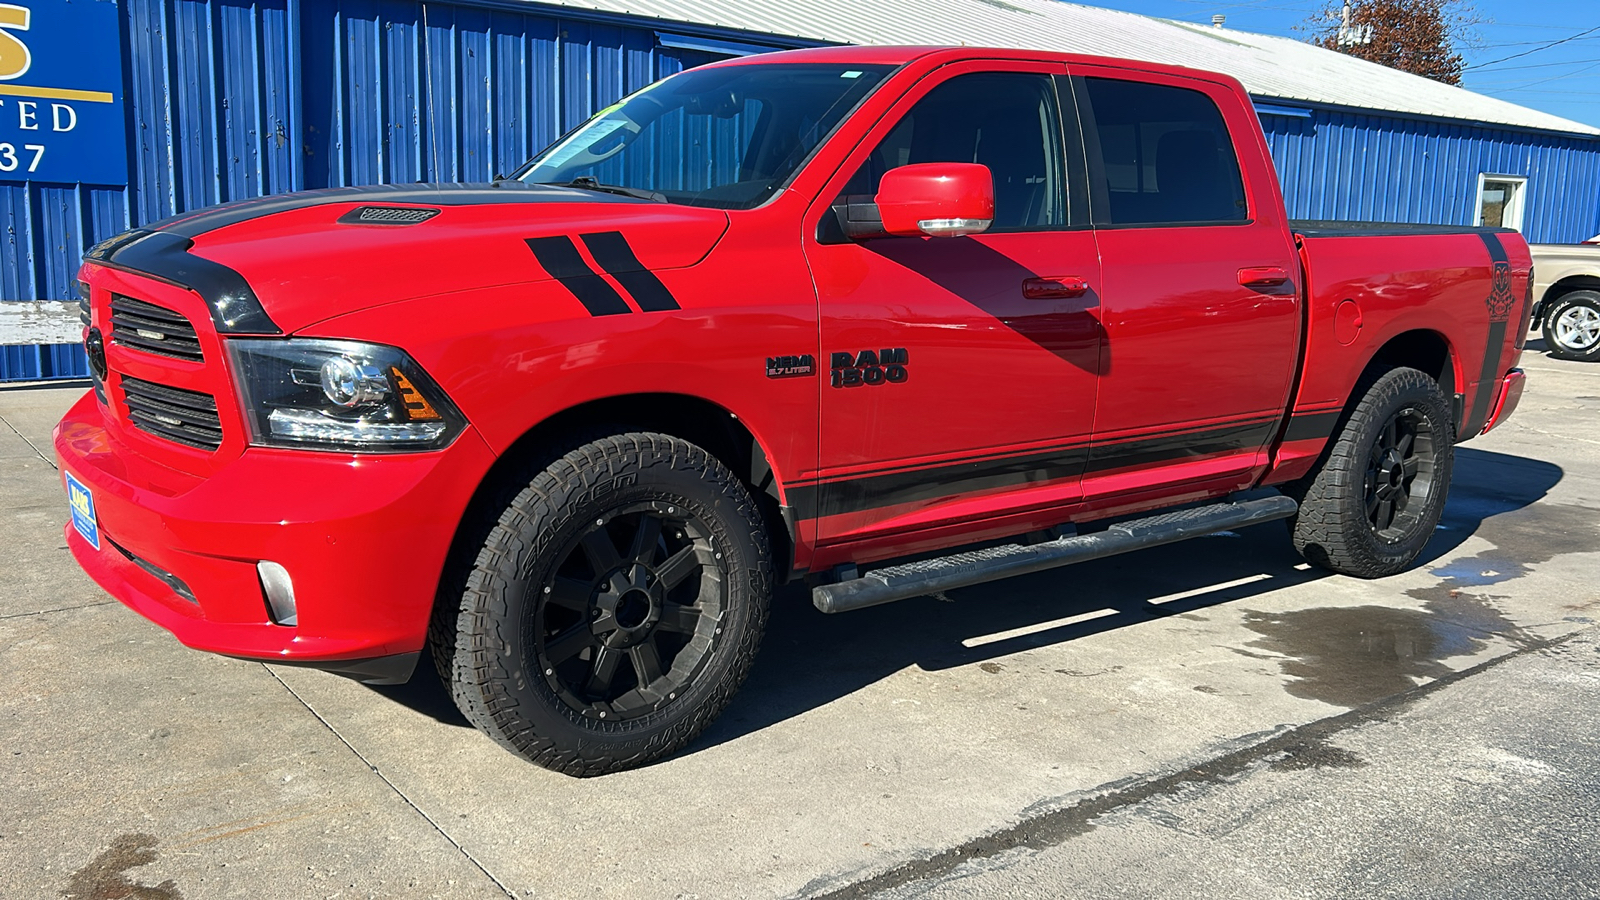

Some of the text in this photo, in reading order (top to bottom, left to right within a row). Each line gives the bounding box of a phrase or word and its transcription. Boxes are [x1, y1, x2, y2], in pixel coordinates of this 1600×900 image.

[766, 354, 814, 368] HEMI
[830, 347, 908, 370] RAM
[768, 365, 811, 376] 5.7 LITER
[830, 365, 908, 388] 1500
[521, 472, 637, 580] FALKEN
